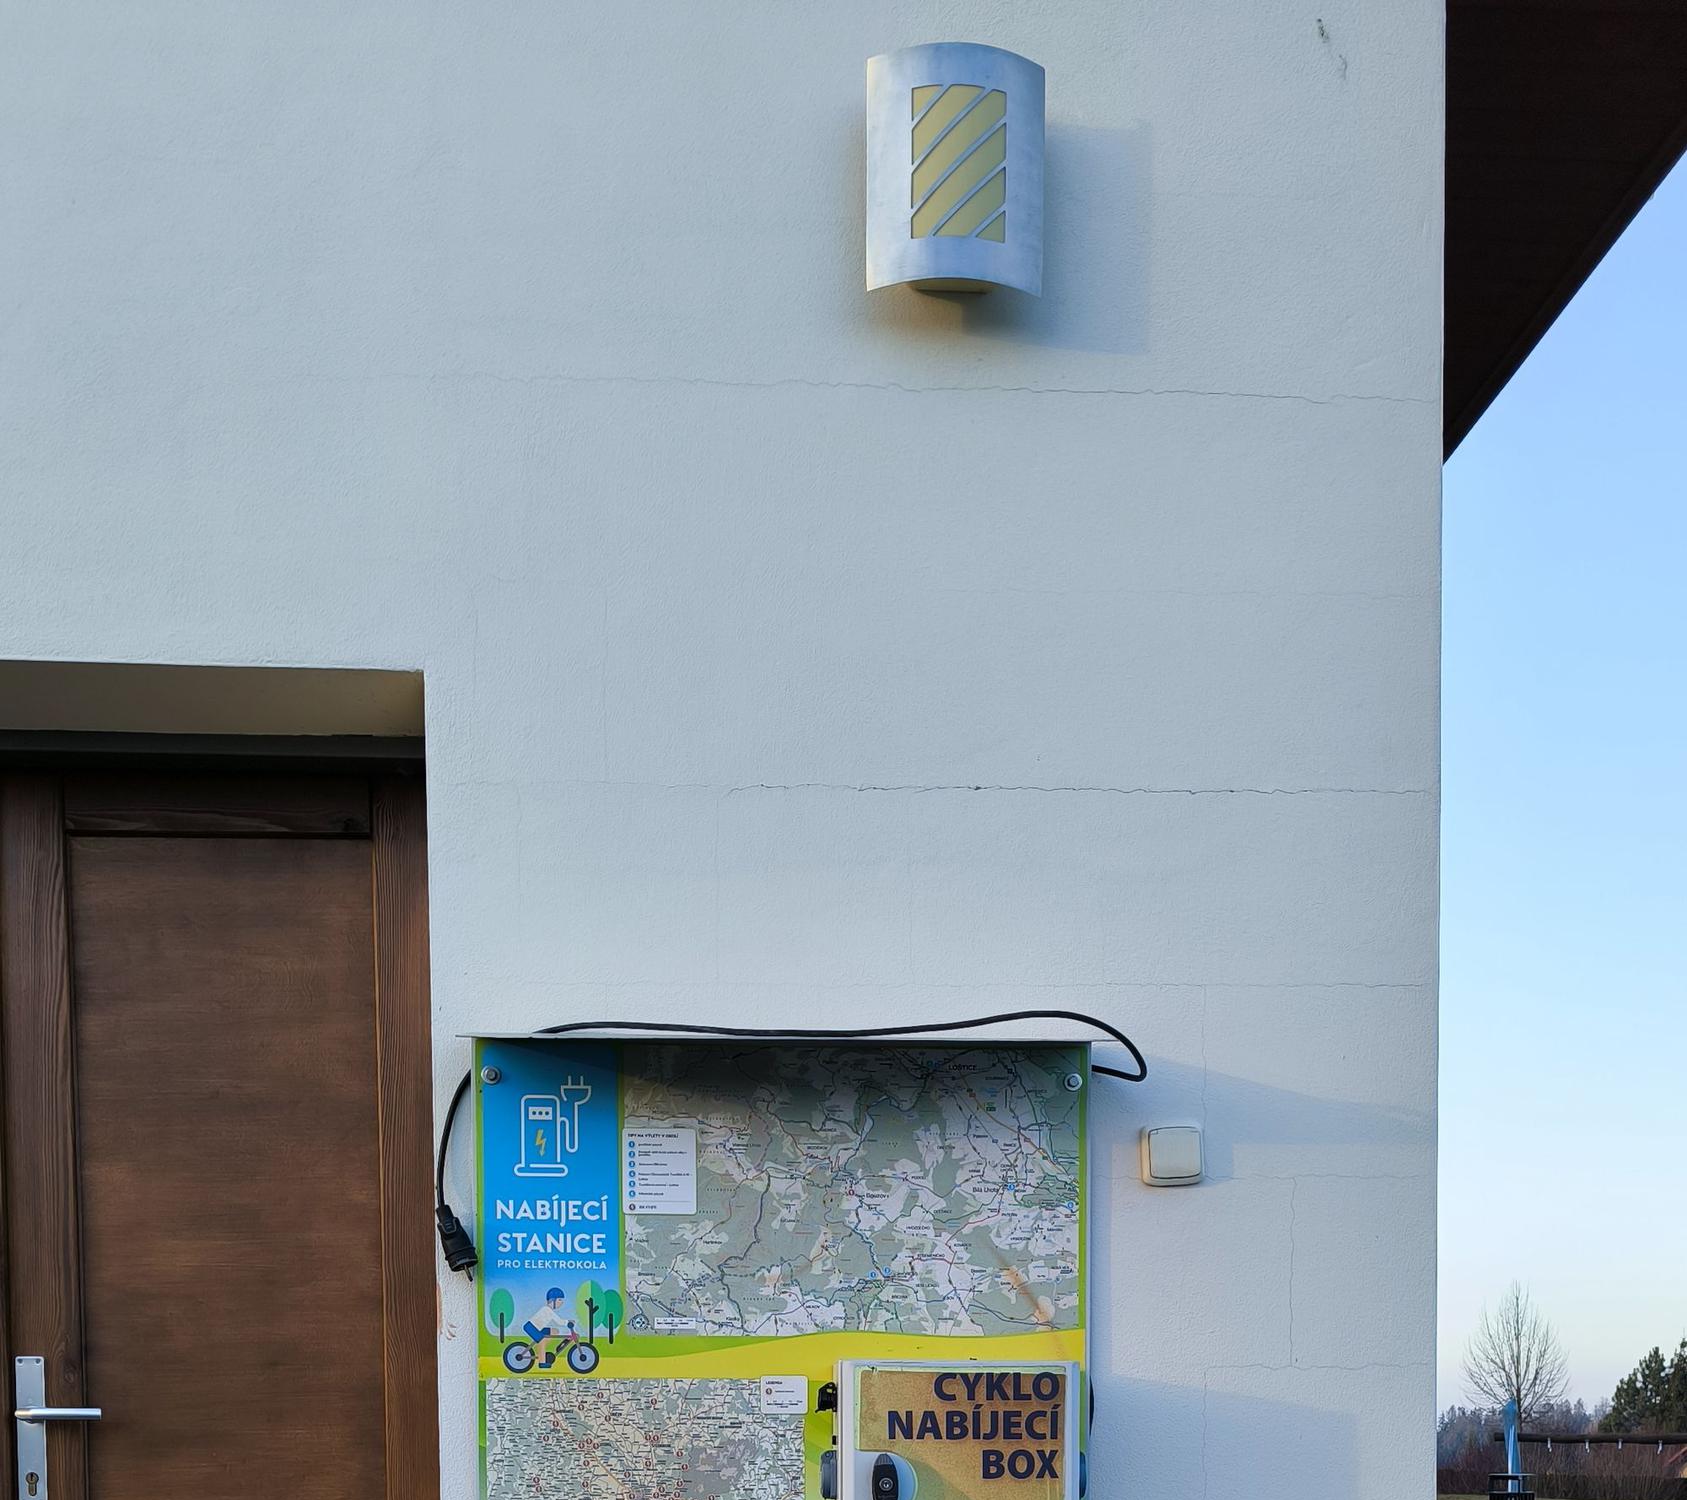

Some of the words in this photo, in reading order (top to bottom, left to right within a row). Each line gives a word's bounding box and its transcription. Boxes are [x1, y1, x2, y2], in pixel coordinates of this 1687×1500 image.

[496, 1194, 609, 1227] NABÍJECÍ
[497, 1232, 607, 1254] STANICE
[497, 1259, 521, 1269] PRO
[524, 1259, 607, 1270] ELEKTROKOLA
[934, 1372, 1060, 1402] CYKLO
[887, 1403, 1062, 1441] NABÍJECÍ
[982, 1449, 1059, 1480] BOX
